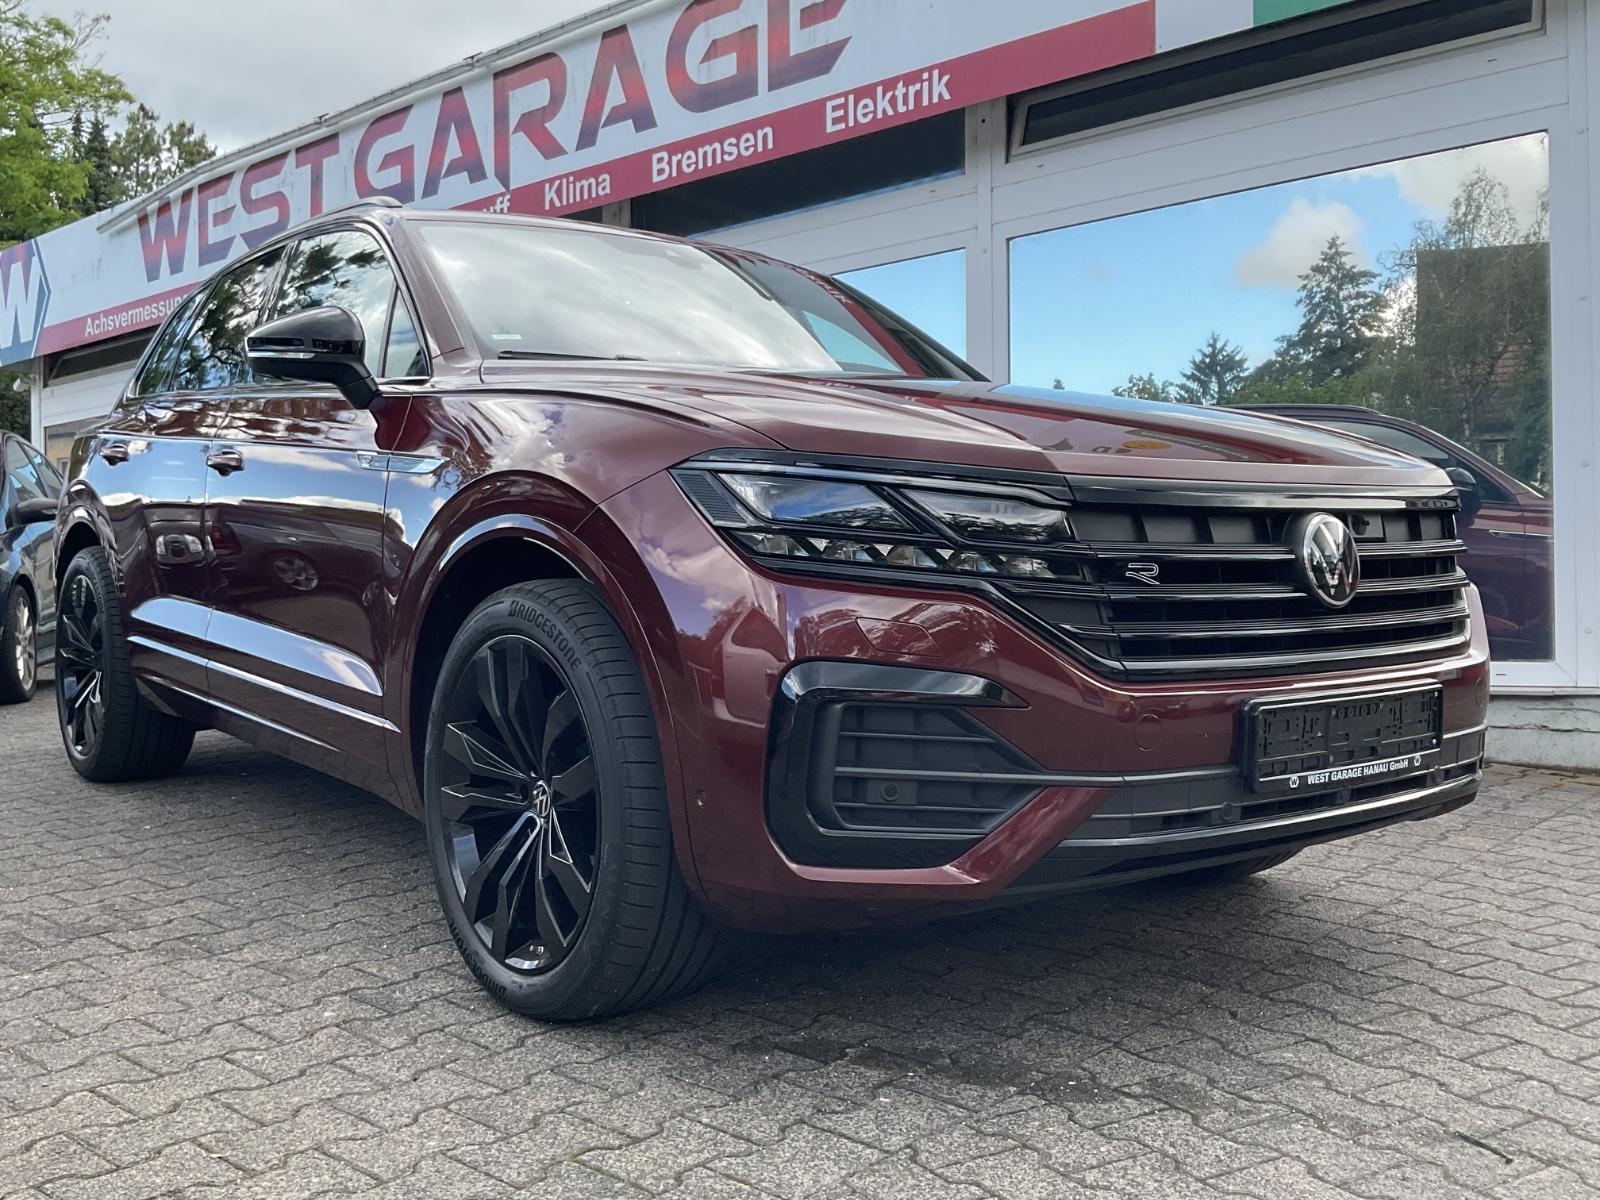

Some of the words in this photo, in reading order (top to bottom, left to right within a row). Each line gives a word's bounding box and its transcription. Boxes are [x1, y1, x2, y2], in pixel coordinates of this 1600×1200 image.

[825, 69, 952, 133] Elektrik
[652, 124, 775, 184] Bremsen
[544, 170, 612, 211] Klima
[85, 294, 188, 337] Achsvermessun
[1126, 562, 1160, 585] R
[507, 600, 583, 672] BRIDGESTONE
[1307, 772, 1330, 785] WEST
[1331, 767, 1362, 781] GARAGE
[1363, 763, 1389, 776] HANAU
[1389, 759, 1409, 771] GmbH
